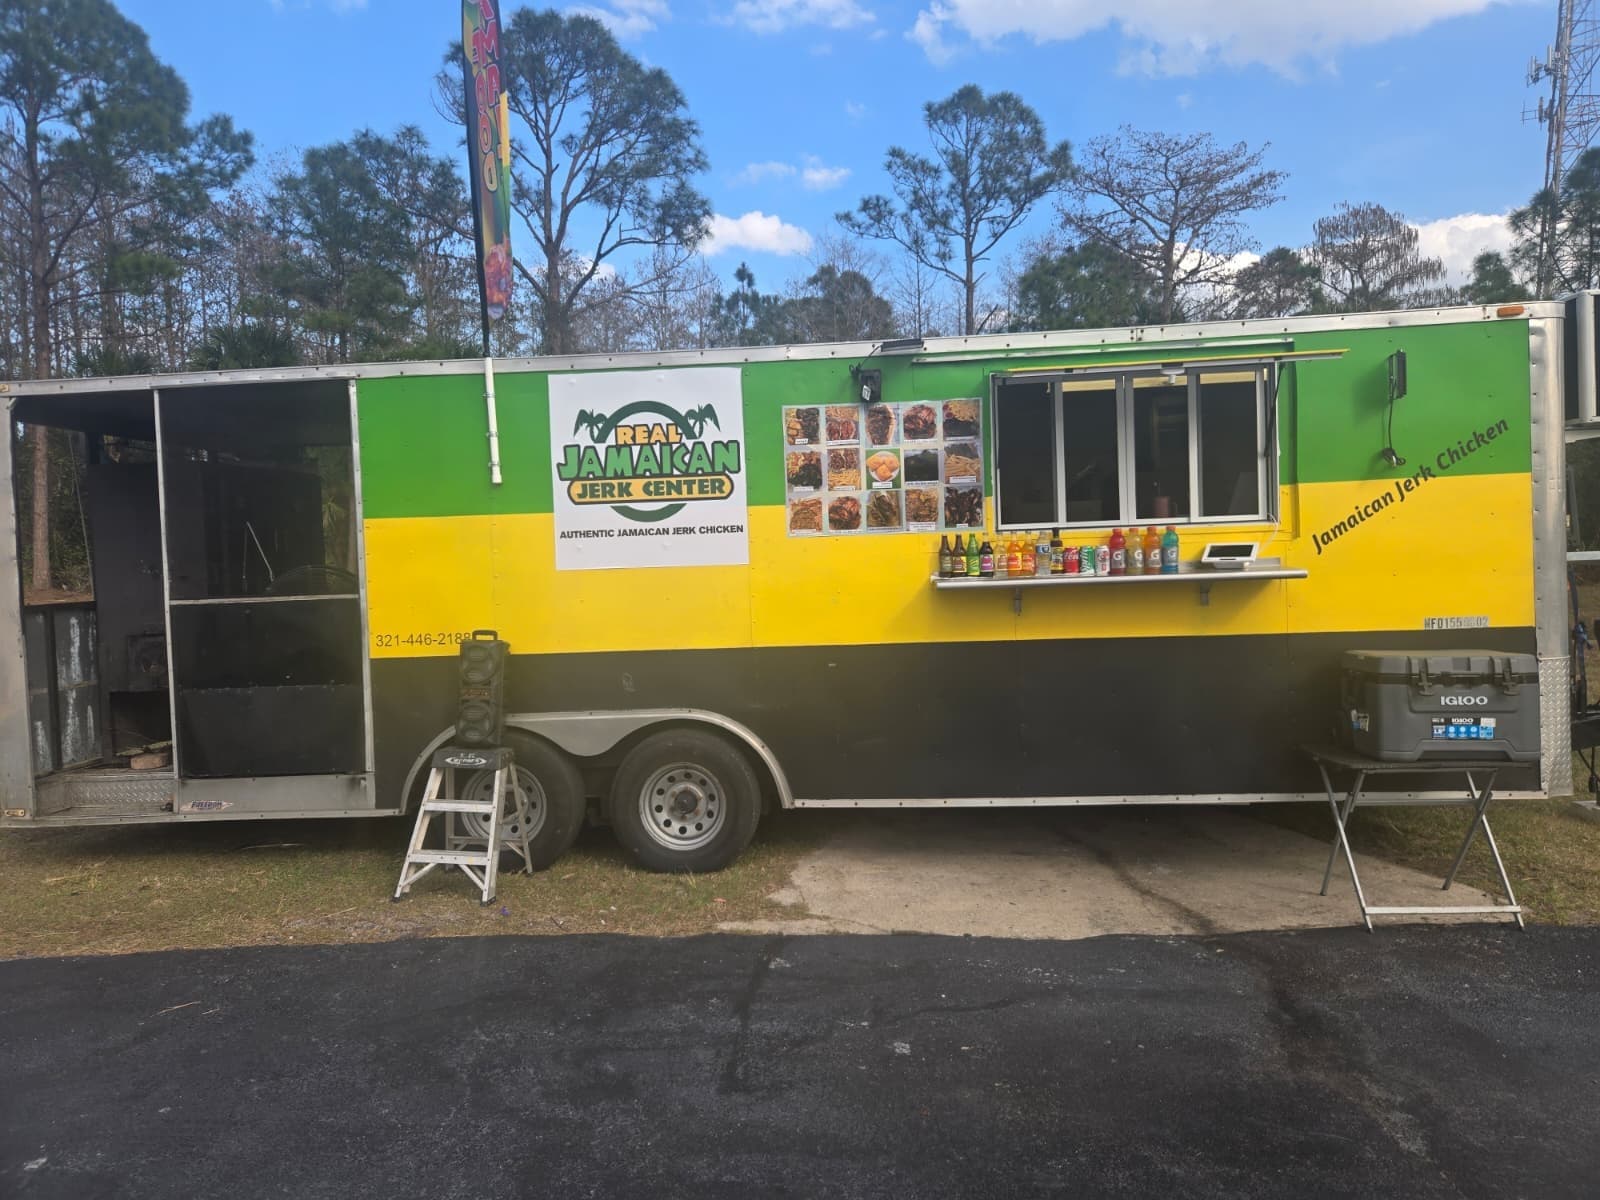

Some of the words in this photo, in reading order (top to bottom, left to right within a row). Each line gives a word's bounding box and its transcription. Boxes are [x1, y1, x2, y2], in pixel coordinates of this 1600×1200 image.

[615, 423, 683, 445] REAL
[556, 440, 741, 481] JAMAICAN
[576, 481, 633, 500] JERK
[642, 478, 726, 498] CENTER
[1312, 491, 1395, 555] Jamaican
[1395, 464, 1437, 502] Jerk
[1436, 418, 1509, 470] Chicken
[559, 529, 615, 539] AUTHENTIC
[617, 527, 670, 538] JAMAICAN
[671, 526, 696, 536] JERK
[698, 524, 744, 535] CHICKEN
[1440, 696, 1488, 706] IGLOO
